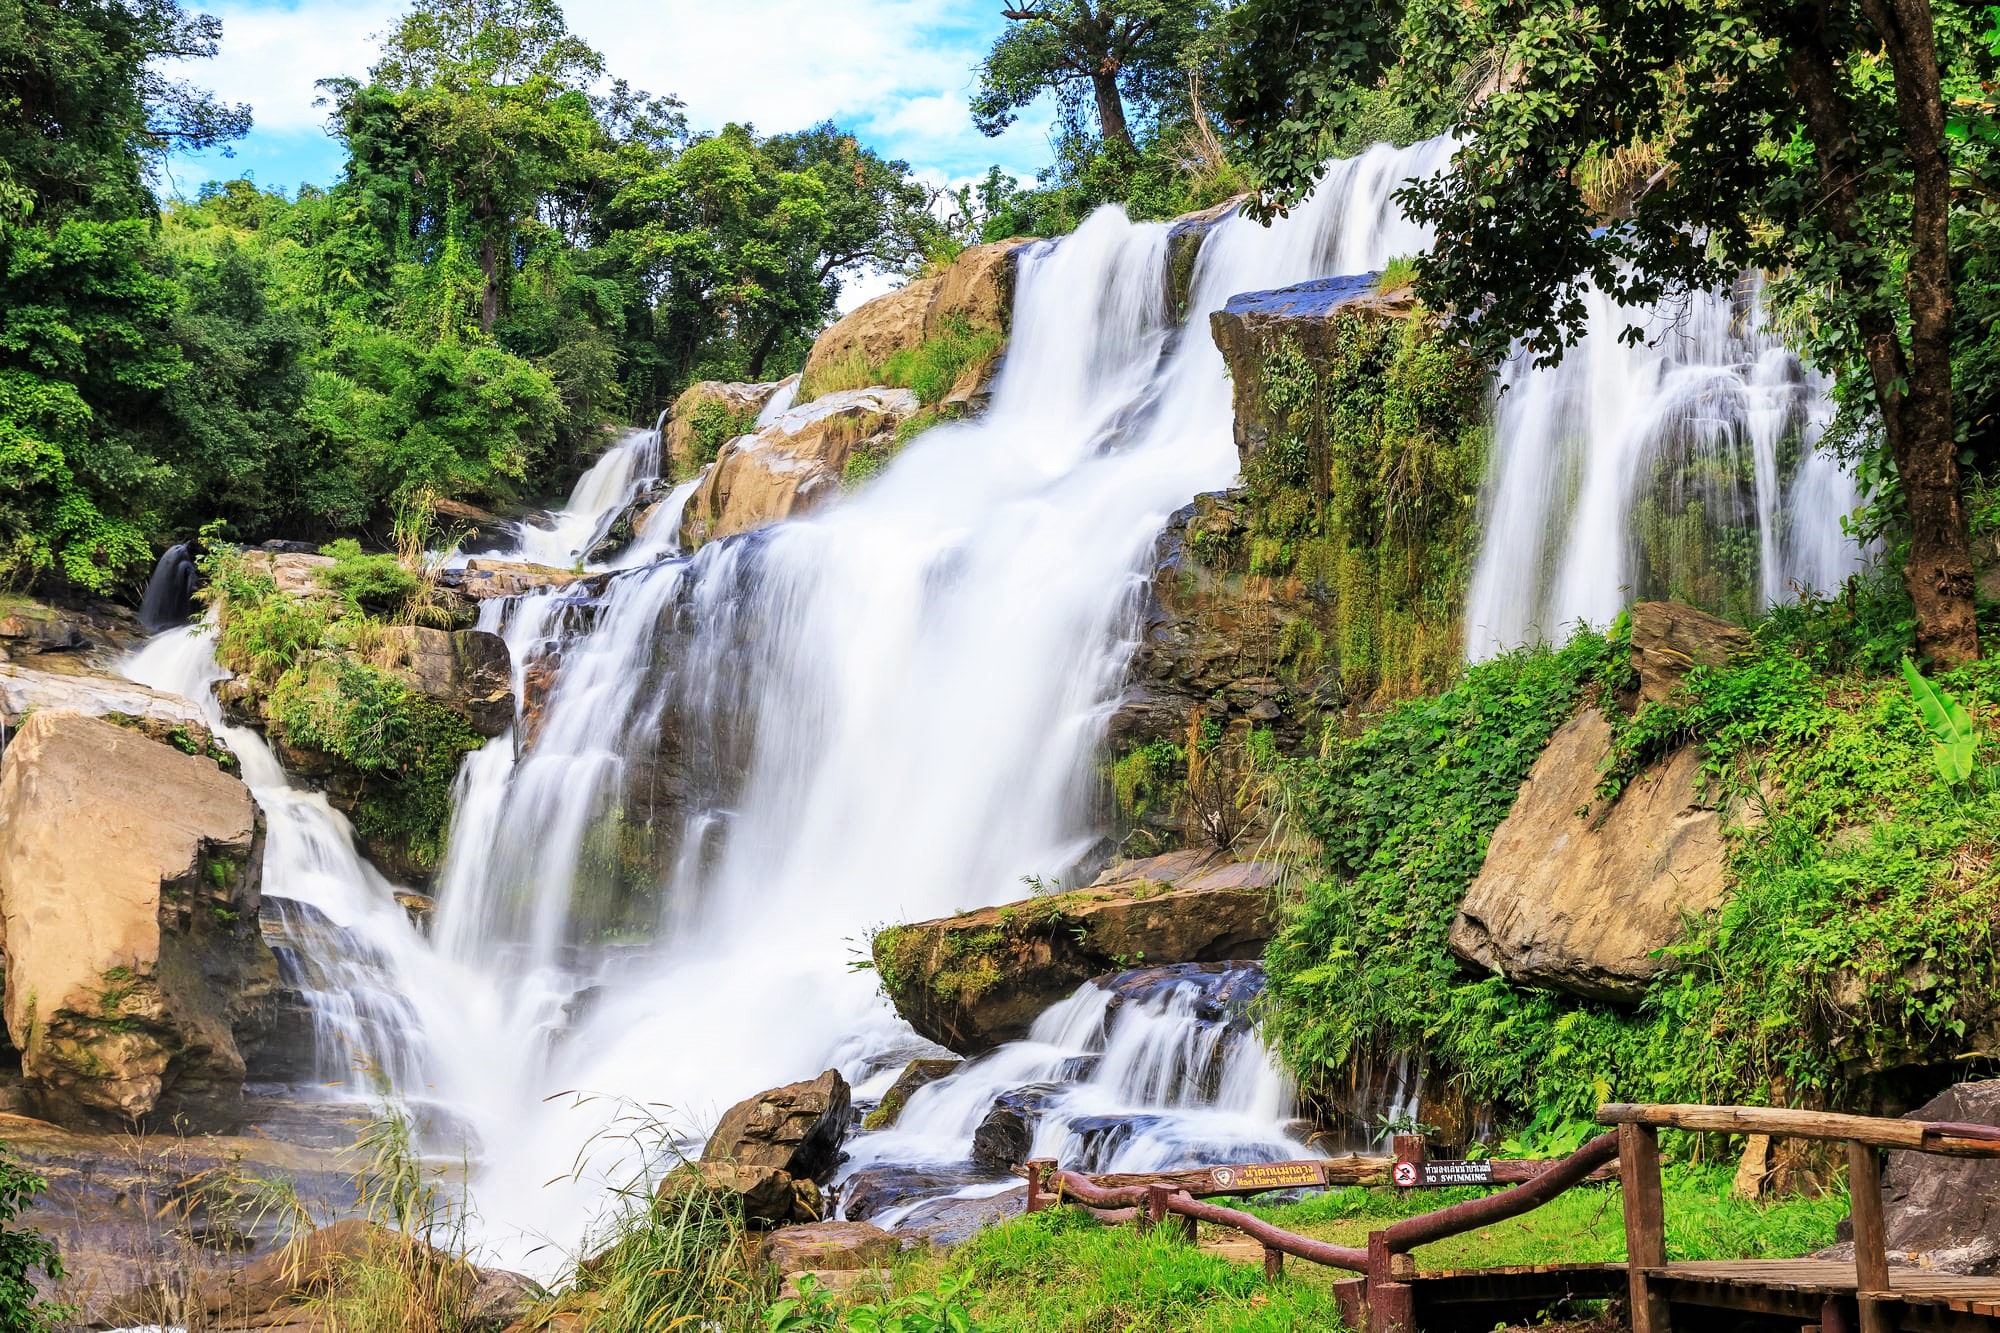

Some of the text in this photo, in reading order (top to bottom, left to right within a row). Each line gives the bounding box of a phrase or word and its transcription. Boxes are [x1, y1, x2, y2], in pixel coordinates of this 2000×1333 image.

[1244, 1164, 1314, 1177] น้ำตกแม่กลาง
[1237, 1173, 1318, 1186] Mae Klang Waterfall
[1427, 1173, 1488, 1183] NO SWIMMING
